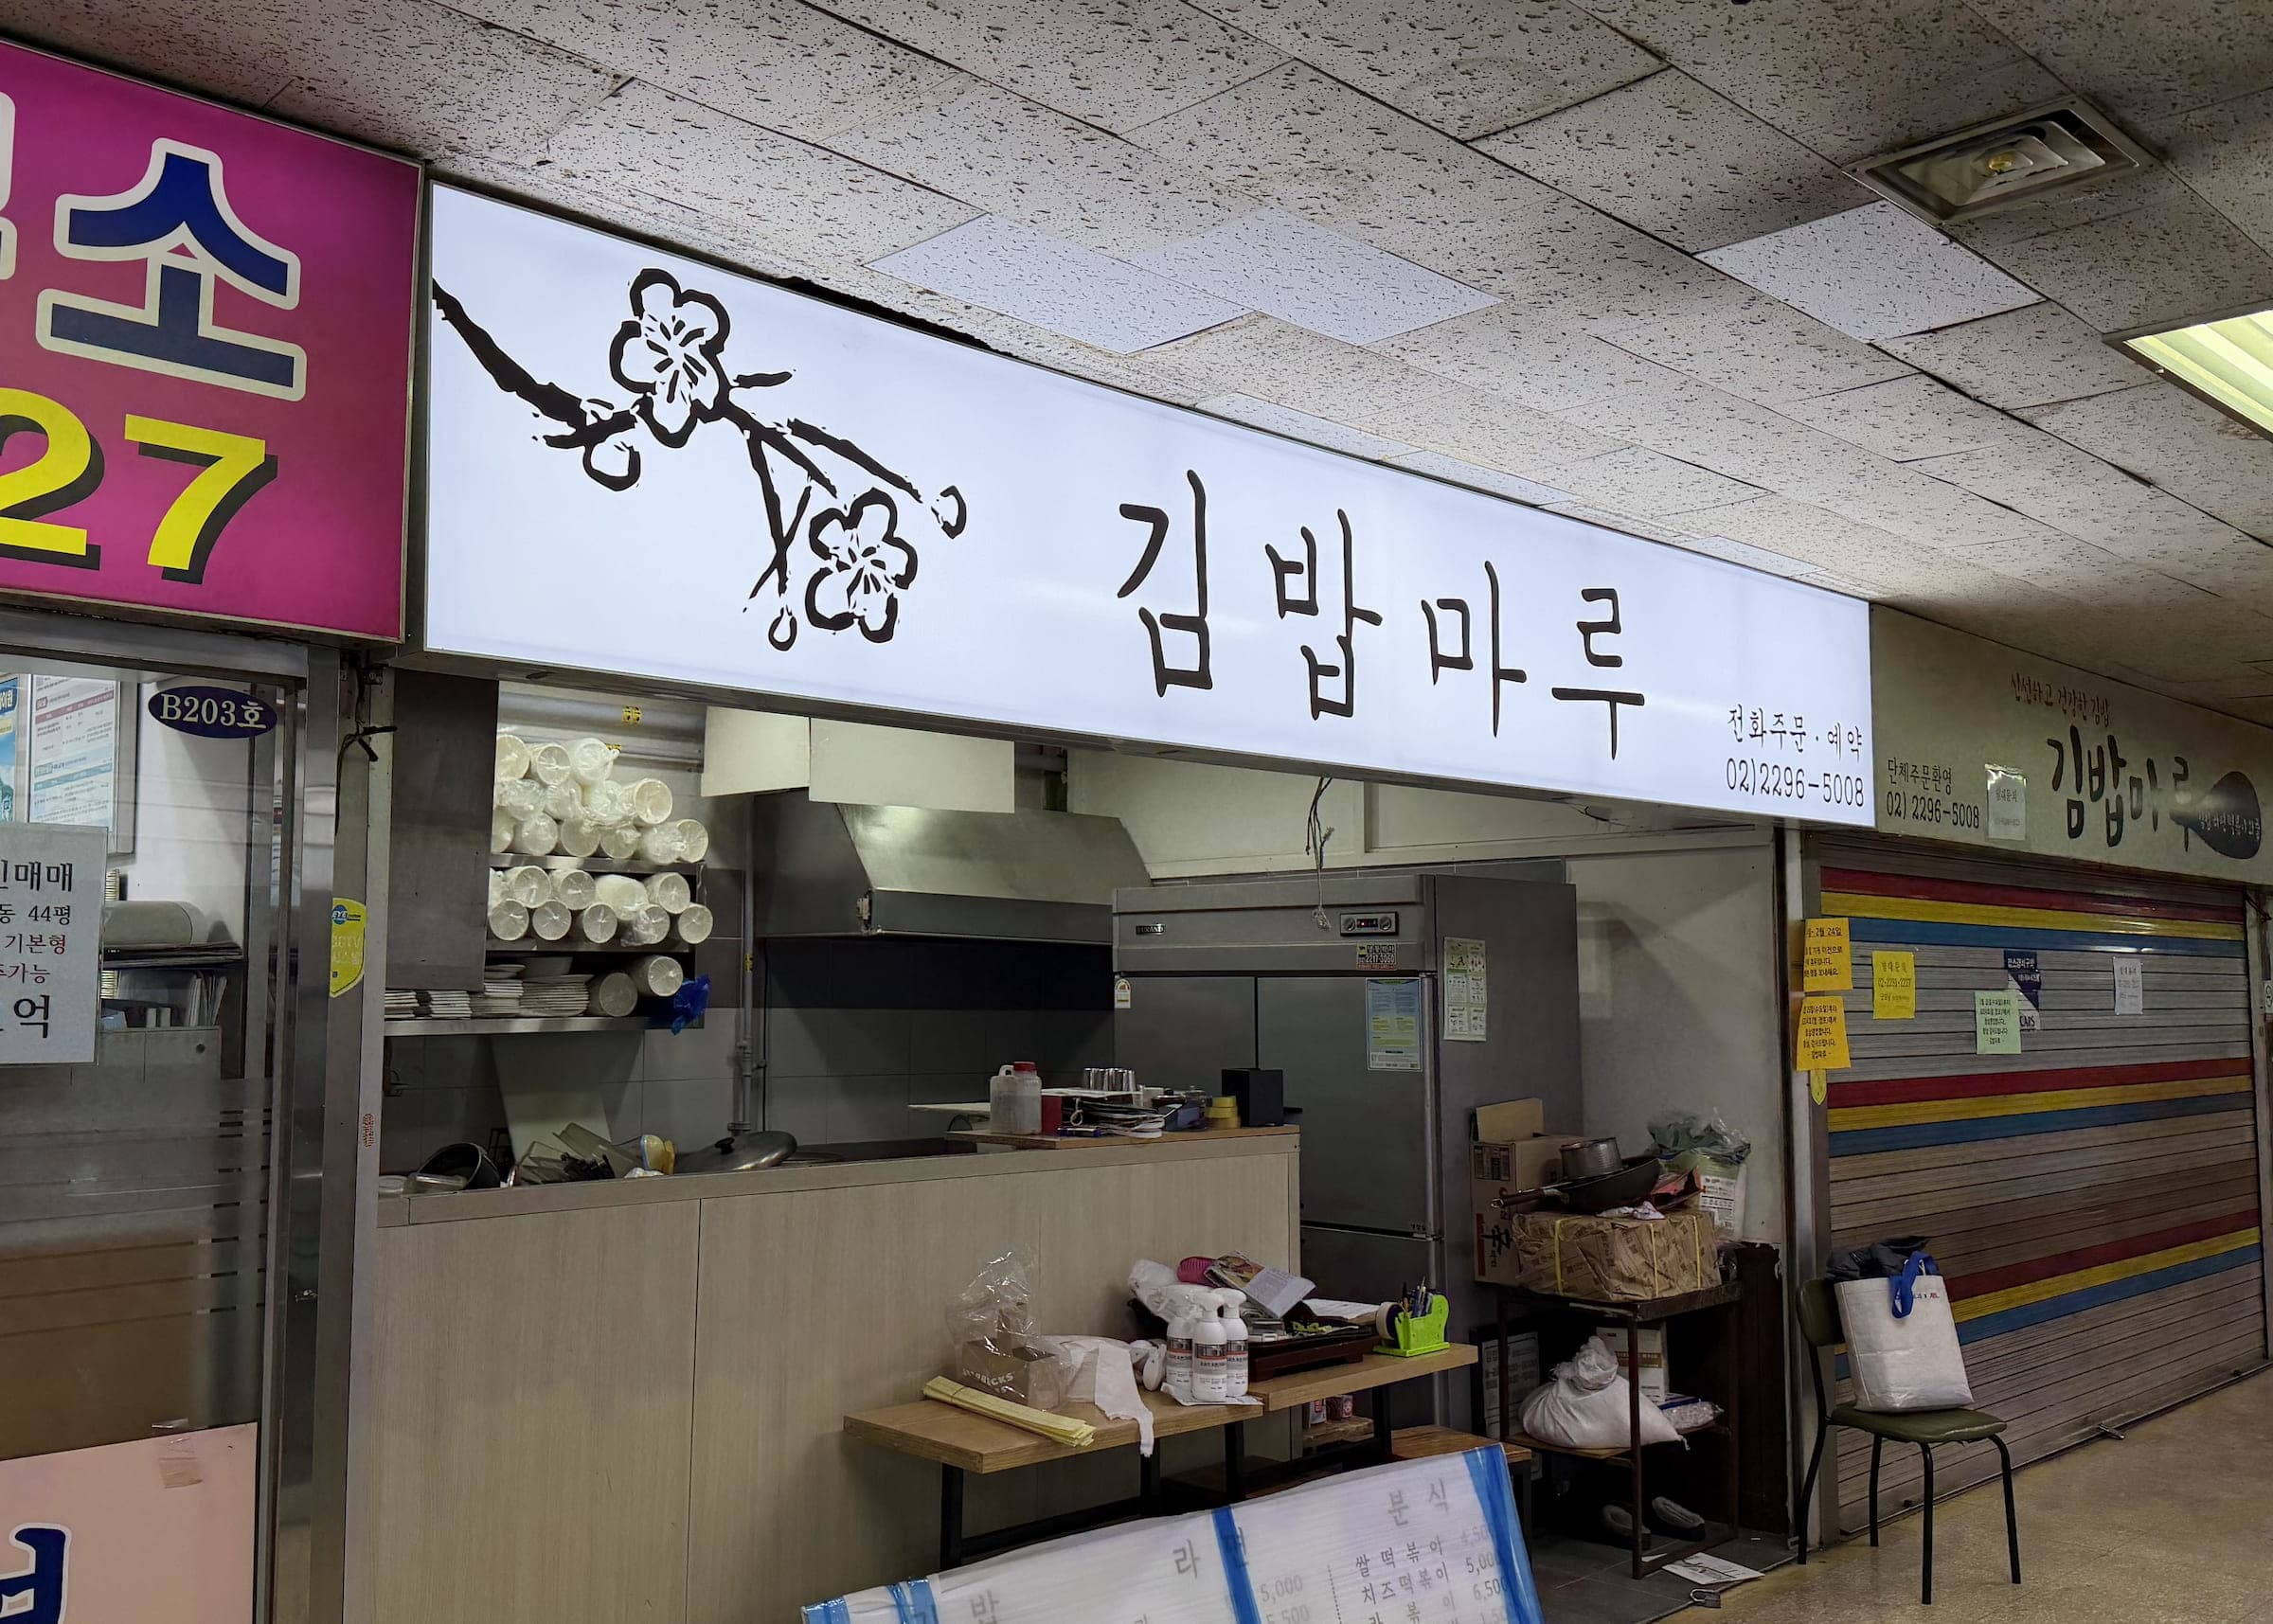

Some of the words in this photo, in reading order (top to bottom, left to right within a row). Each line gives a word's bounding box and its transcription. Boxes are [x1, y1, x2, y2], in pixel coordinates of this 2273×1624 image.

[0, 90, 306, 402] 소
[0, 386, 277, 585] 27
[1118, 469, 1645, 760] 김밥마루
[159, 692, 267, 731] B203호
[2090, 696, 2110, 728] 김밥
[1726, 757, 1865, 807] 02)2296-5008
[27, 904, 71, 926] 44평
[5, 934, 66, 955] 기본형
